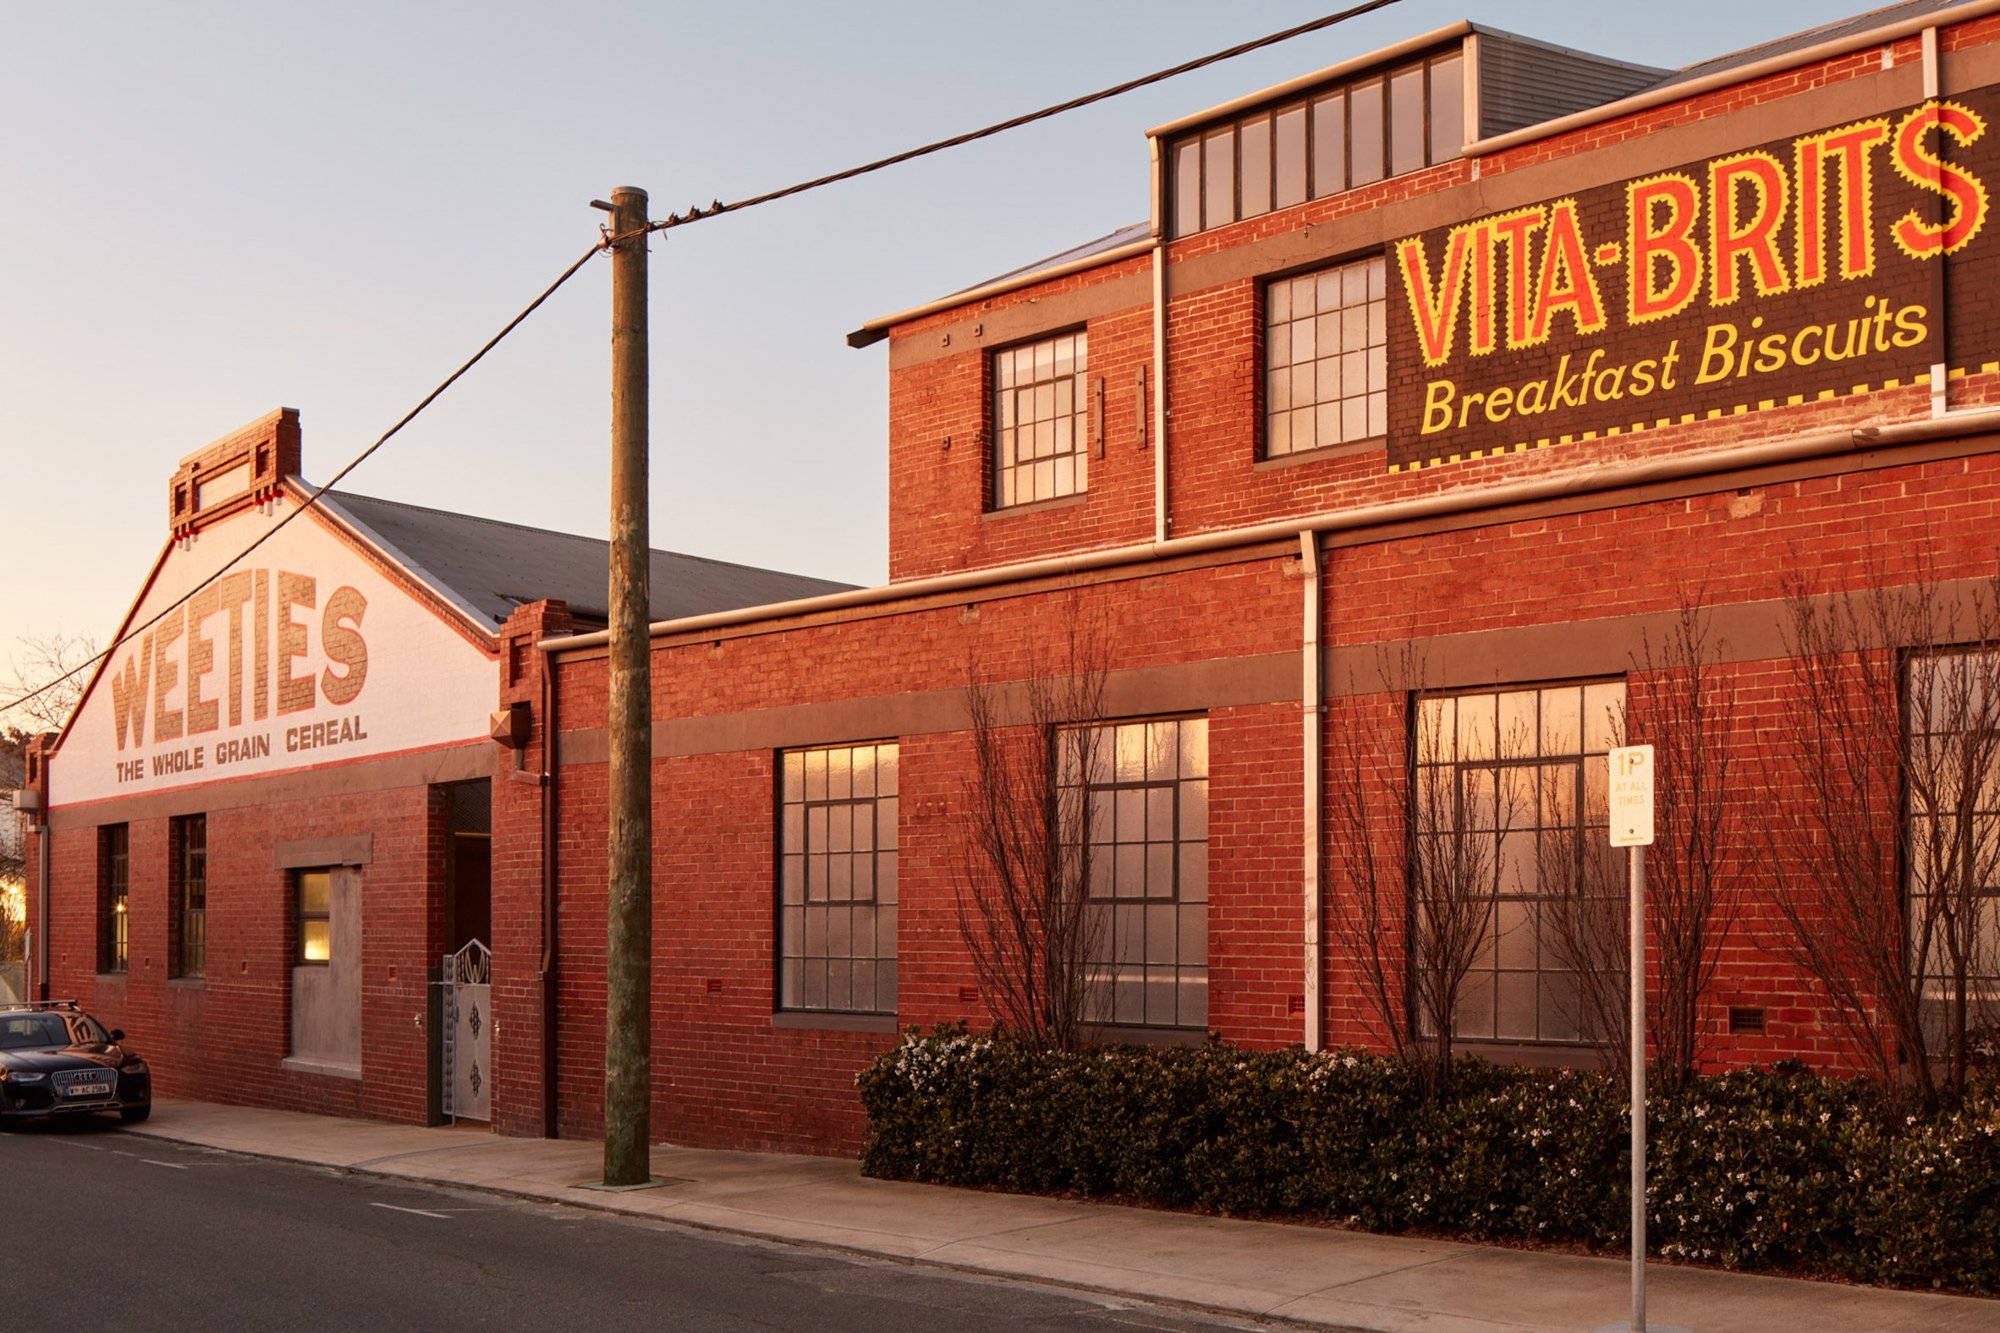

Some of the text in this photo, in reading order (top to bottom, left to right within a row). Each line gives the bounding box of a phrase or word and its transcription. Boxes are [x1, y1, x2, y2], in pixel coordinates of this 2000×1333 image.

[1396, 100, 1989, 367] VITA-BRITS
[1420, 295, 1928, 434] Breakfast Biscuits
[112, 568, 368, 751] WEETIES
[116, 716, 367, 783] THE WHOLE GRAIN CEREAL
[1617, 752, 1645, 776] 1P
[1615, 781, 1648, 793] AT ALL
[1618, 795, 1645, 806] TIMES
